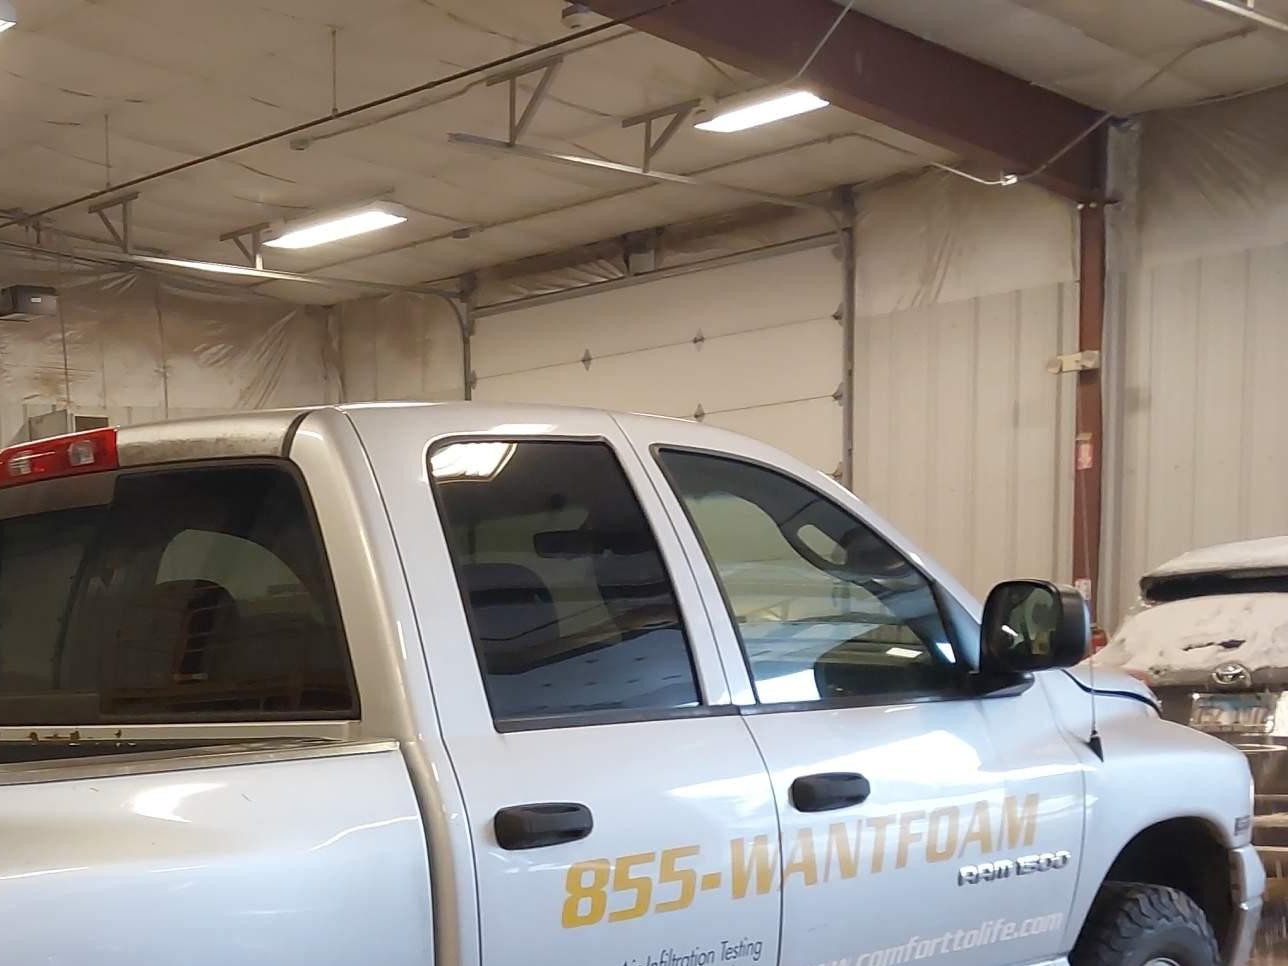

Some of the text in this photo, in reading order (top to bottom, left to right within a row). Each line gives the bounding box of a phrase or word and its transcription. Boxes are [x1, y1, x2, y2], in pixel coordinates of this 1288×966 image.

[561, 793, 1040, 929] 855-WANTFOAM
[957, 850, 1072, 887] RAM 1500
[720, 937, 763, 962] Testing
